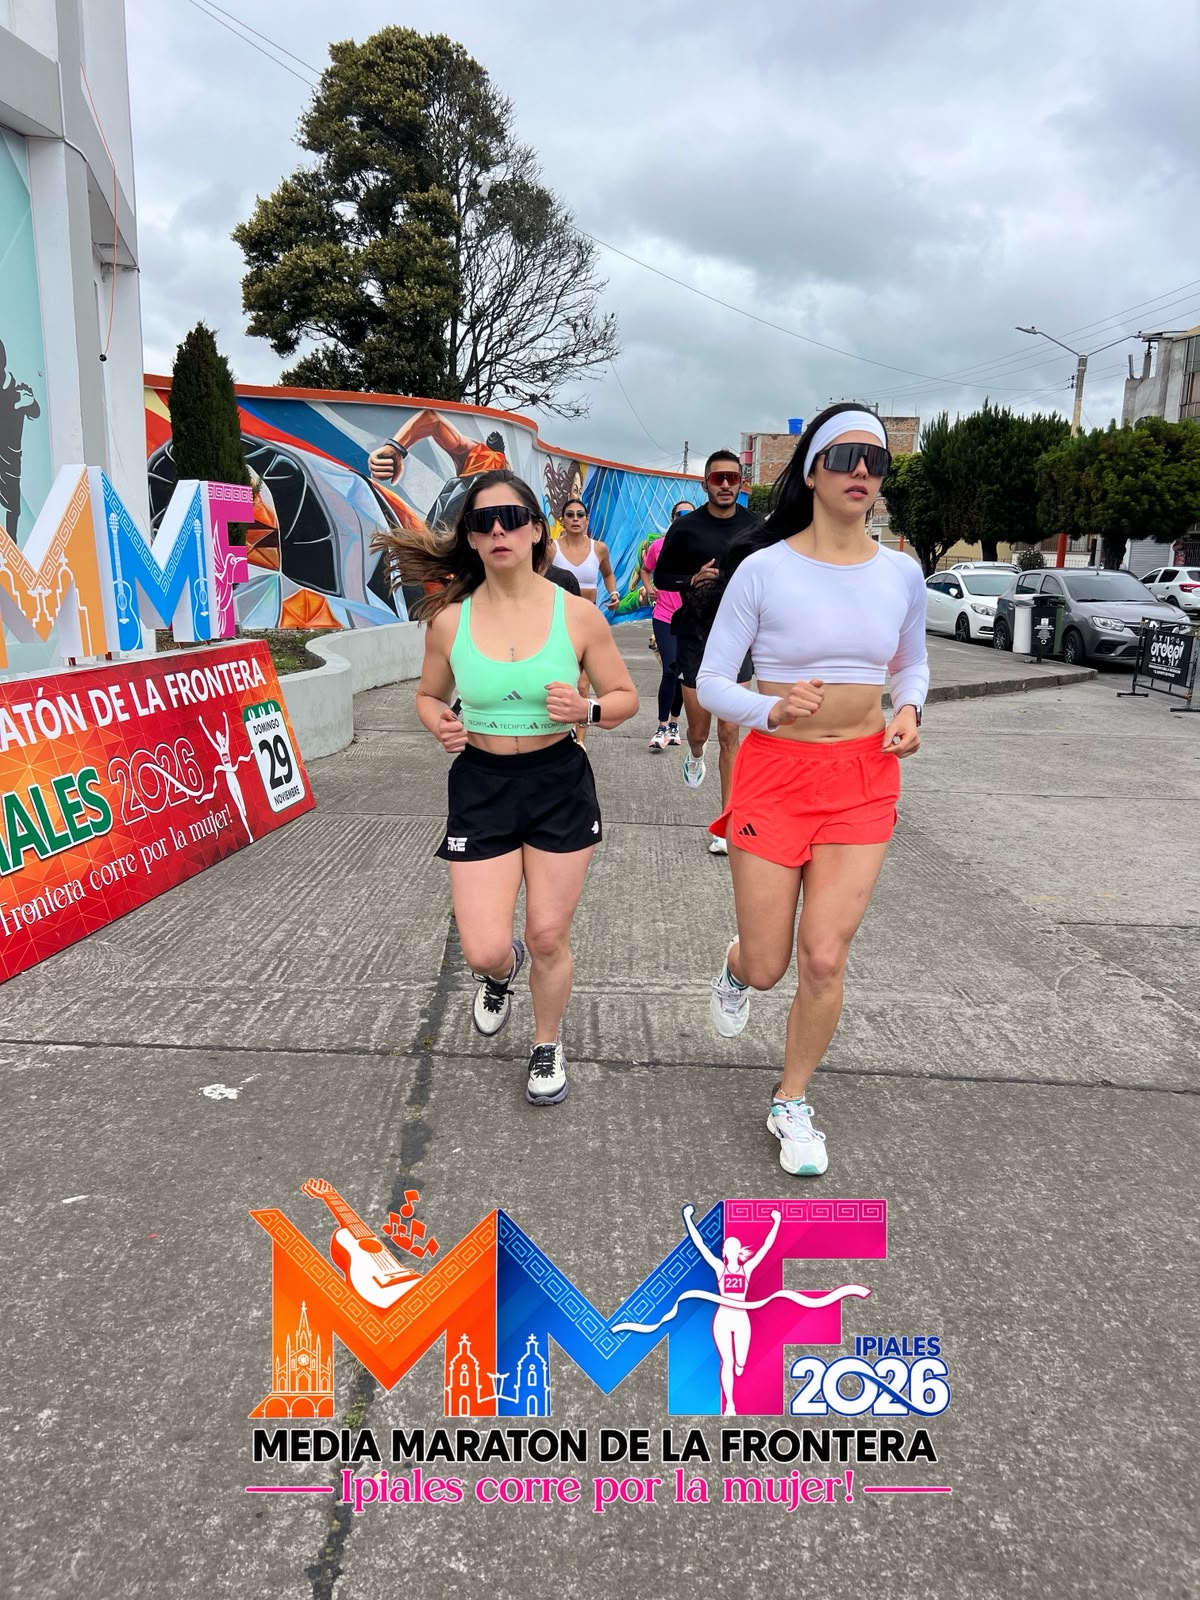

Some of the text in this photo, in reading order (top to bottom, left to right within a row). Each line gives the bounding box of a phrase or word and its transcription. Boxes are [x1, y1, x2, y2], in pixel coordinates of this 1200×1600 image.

[88, 684, 131, 727] DE
[128, 678, 167, 717] LA
[164, 657, 267, 709] FRONTERA
[253, 718, 280, 735] DOMINGO
[468, 719, 487, 728] TECHFIT
[107, 737, 204, 826] 2026
[258, 734, 293, 790] 29
[273, 785, 301, 806] NOVIEMBRE
[0, 803, 233, 937] Frontera corre por la mujer!
